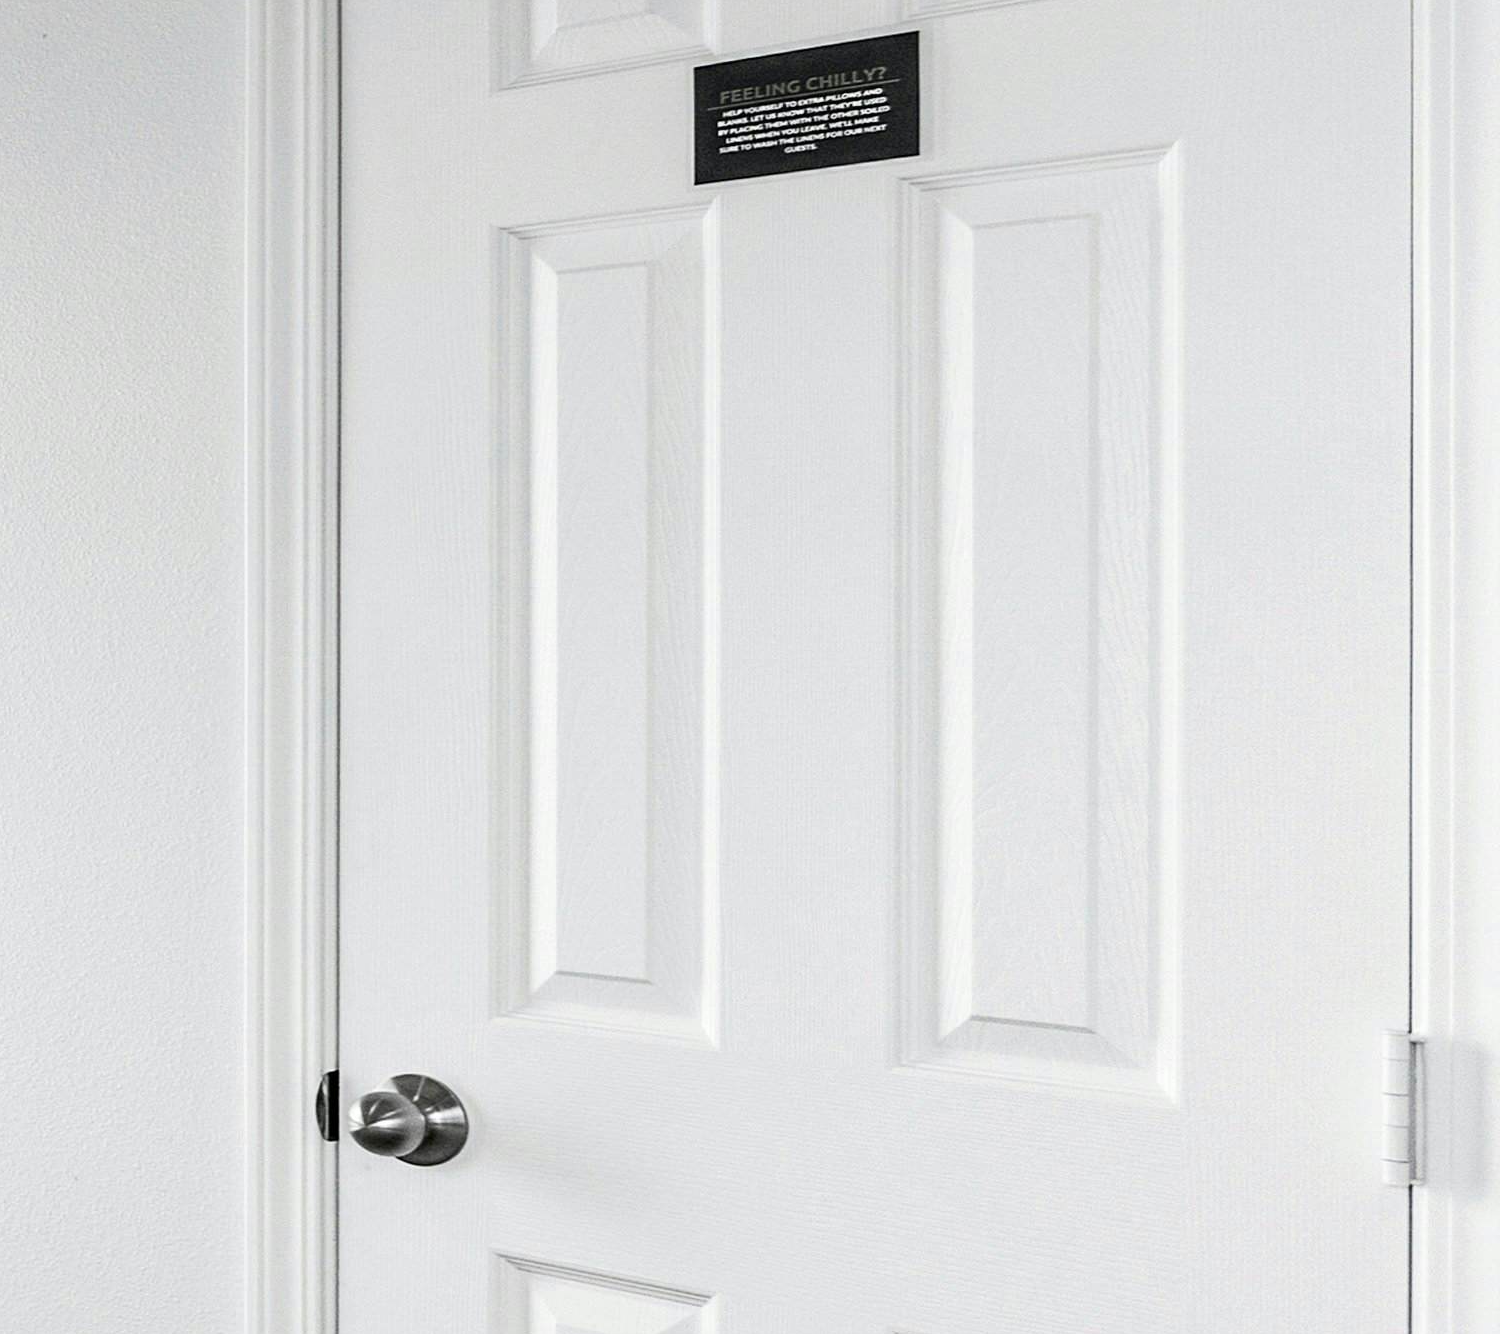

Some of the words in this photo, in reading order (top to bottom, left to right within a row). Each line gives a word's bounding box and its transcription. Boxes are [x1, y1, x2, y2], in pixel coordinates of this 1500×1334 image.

[720, 80, 800, 104] FEELING
[806, 67, 886, 90] CHILLY?
[722, 109, 743, 117] HELP
[744, 103, 783, 114] YOURSELF
[785, 100, 797, 108] TO
[798, 97, 824, 107] EXTRA
[825, 91, 862, 101] PILLOWS
[863, 88, 883, 96] AND
[750, 114, 764, 122] LET
[765, 112, 777, 120] US
[777, 109, 804, 118] KNOW
[806, 105, 828, 114] THAT
[863, 96, 887, 106] USED
[725, 134, 753, 144] LINENS
[754, 131, 780, 140] WHEN
[854, 116, 880, 125] MAKE
[730, 124, 763, 134] PLACING
[764, 120, 788, 129] THEM
[789, 117, 812, 125] WITH
[813, 114, 829, 122] THE
[830, 109, 859, 119] OTHER
[740, 143, 752, 151] TO
[752, 140, 778, 149] WASH
[779, 137, 795, 145] THE
[795, 133, 825, 142] LINENS
[825, 130, 843, 138] FOR
[843, 127, 863, 135] OUR
[863, 124, 888, 132] NEXT
